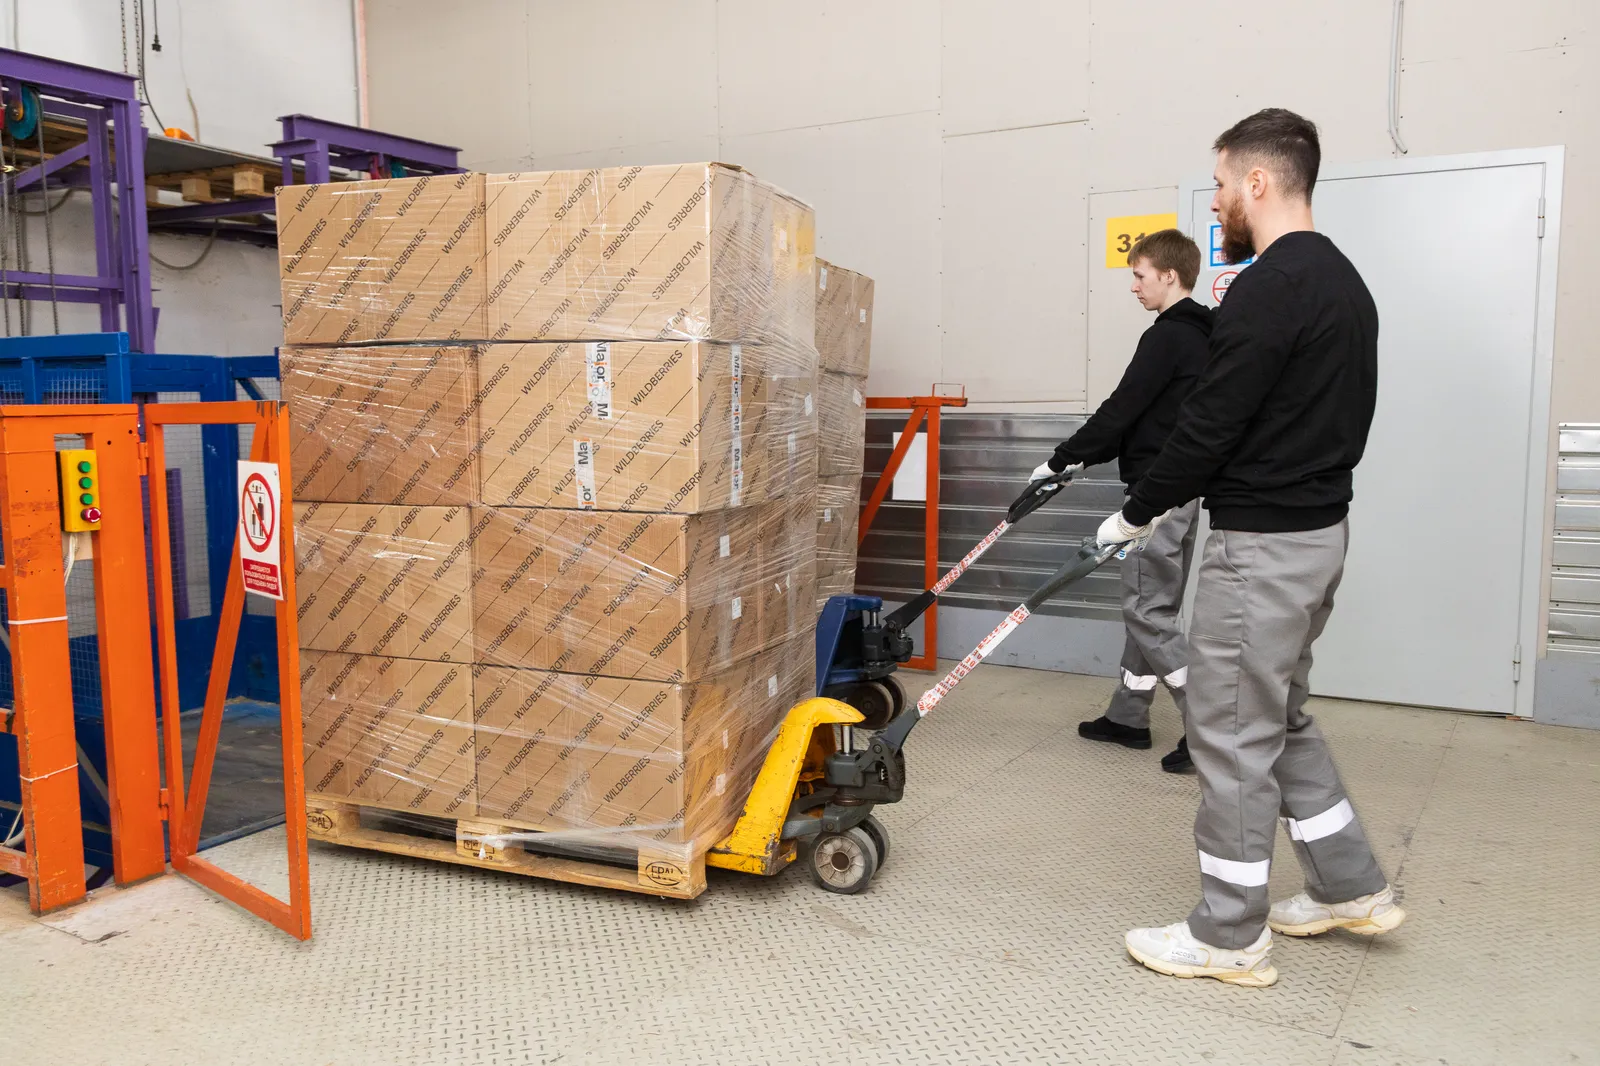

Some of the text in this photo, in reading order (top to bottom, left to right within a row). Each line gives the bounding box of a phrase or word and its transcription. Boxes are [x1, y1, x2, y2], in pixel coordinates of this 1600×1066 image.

[339, 192, 383, 249] WILDBERRIES
[494, 189, 542, 247] WILDBERRIES
[603, 201, 654, 260] WILDBERRIES
[285, 219, 327, 274] WILDBERRIES
[383, 229, 427, 284] WILDBERRIES
[540, 228, 590, 285] WILDBERRIES
[652, 241, 704, 300] WILDBERRIES
[428, 266, 473, 322] WILDBERRIES
[588, 267, 639, 324] WILDBERRIES
[631, 350, 683, 406] WILDBERRIES
[400, 401, 442, 452] WILDBERRIES
[508, 403, 554, 456] WILDBERRIES
[613, 420, 664, 474] WILDBERRIES
[294, 447, 334, 497] WILDBERRIES
[337, 516, 377, 566] WILDBERRIES
[501, 544, 543, 593] WILDBERRIES
[328, 574, 366, 621] WILDBERRIES
[419, 595, 461, 643] WILDBERRIES
[416, 669, 458, 714] WILDBERRIES
[619, 691, 668, 741] WILDBERRIES
[604, 755, 651, 803] WILDBERRIES
